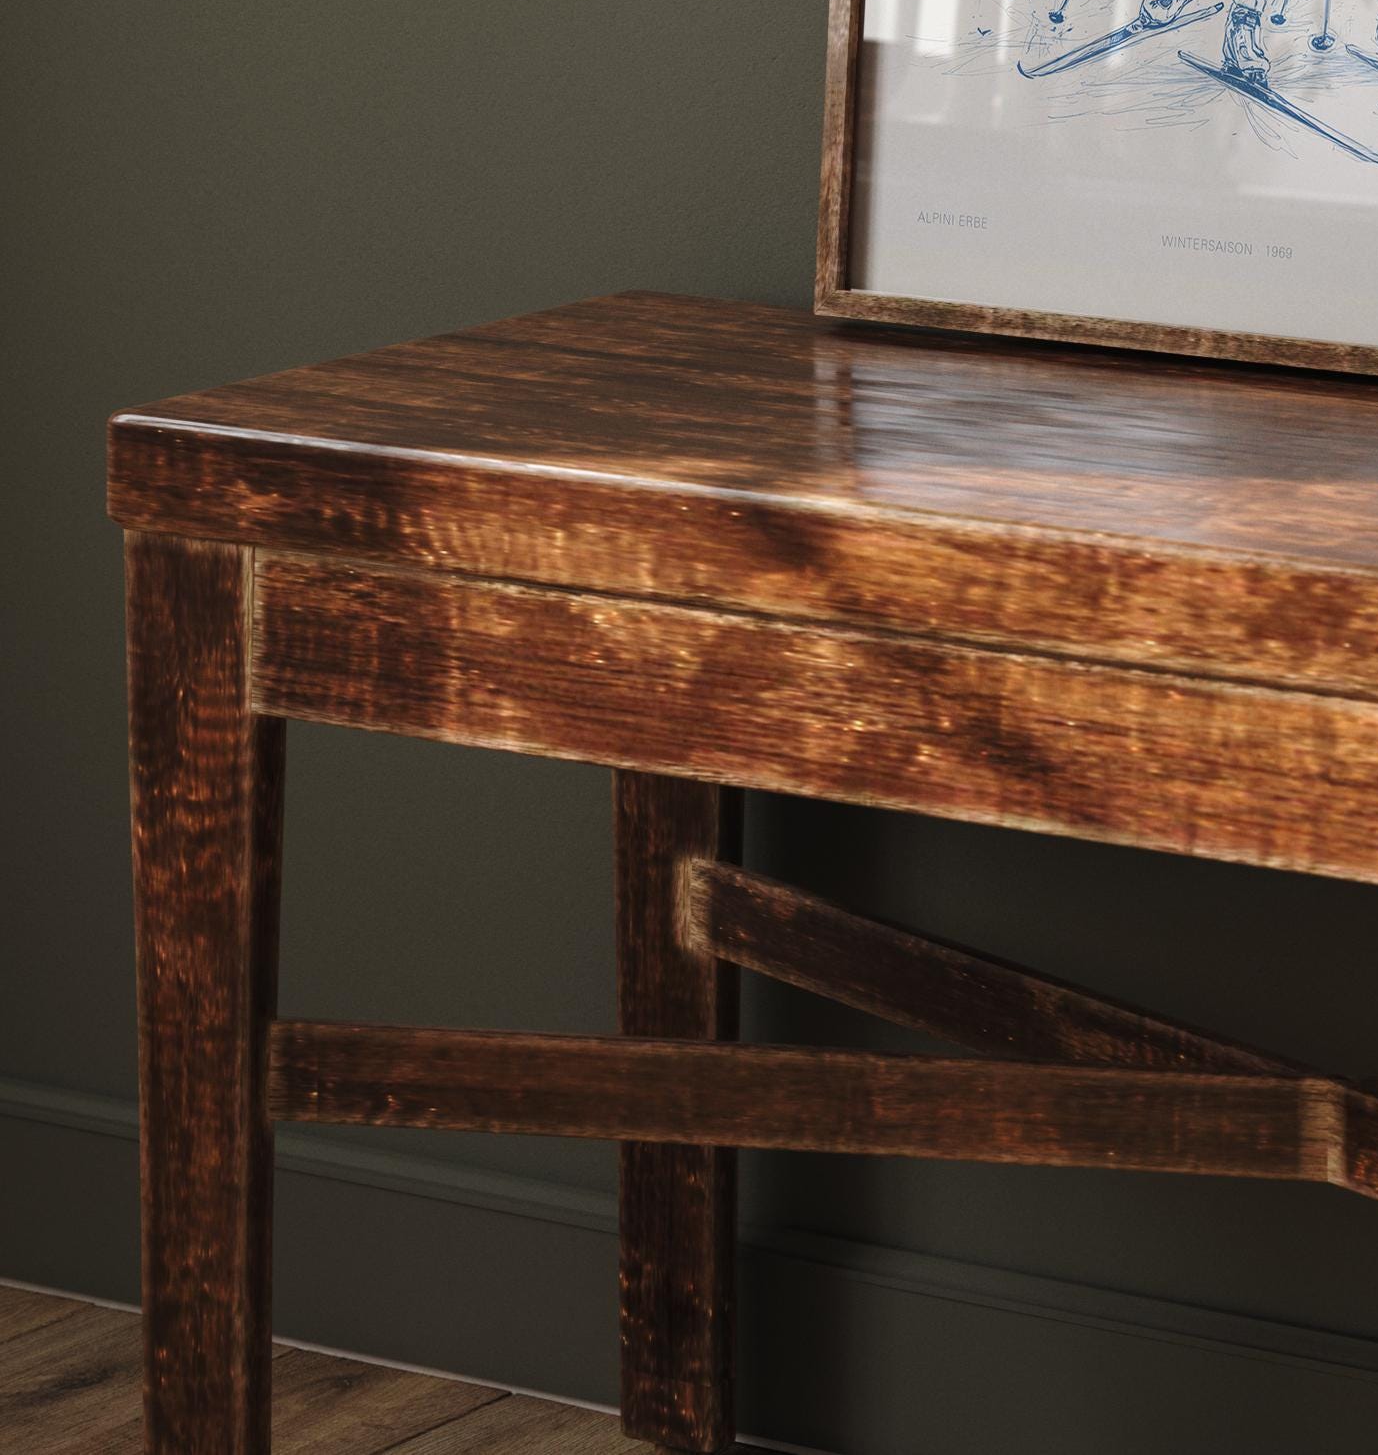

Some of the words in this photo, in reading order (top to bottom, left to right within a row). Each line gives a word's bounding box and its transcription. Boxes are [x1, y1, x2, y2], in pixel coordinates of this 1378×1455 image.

[917, 211, 955, 226] ALPINI
[958, 214, 988, 230] ERBE
[1161, 235, 1253, 255] WINTERSAISON
[1266, 245, 1293, 259] 1969
